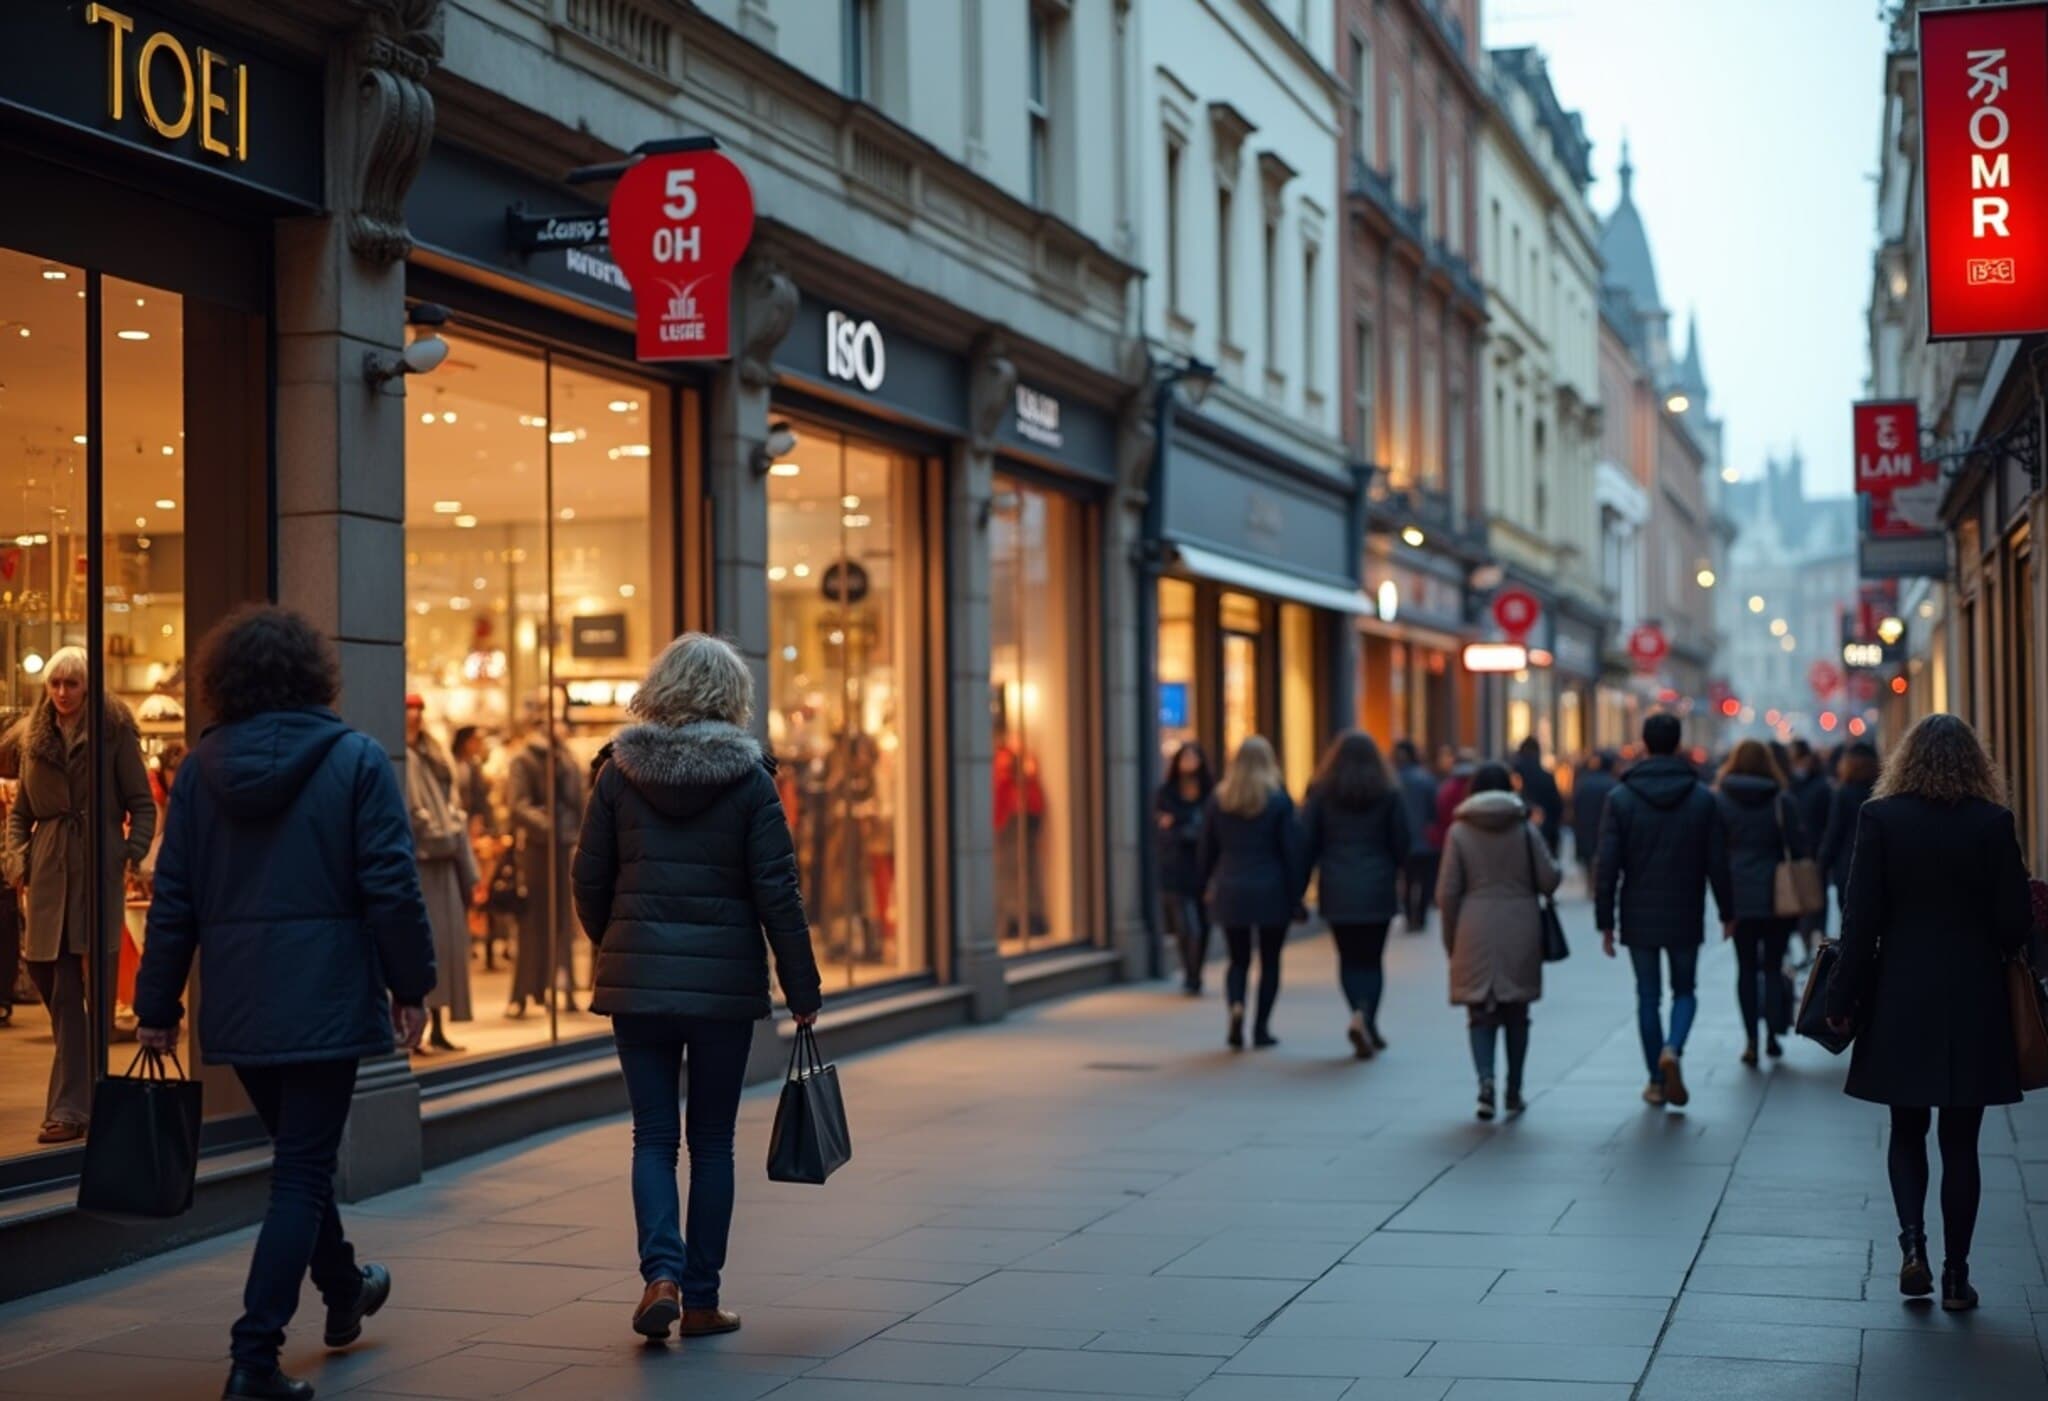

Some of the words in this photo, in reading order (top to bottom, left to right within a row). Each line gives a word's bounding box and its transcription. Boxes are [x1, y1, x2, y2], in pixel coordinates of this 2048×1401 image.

[86, 2, 247, 161] TOEI
[663, 168, 697, 220] 5
[827, 311, 885, 391] ISO
